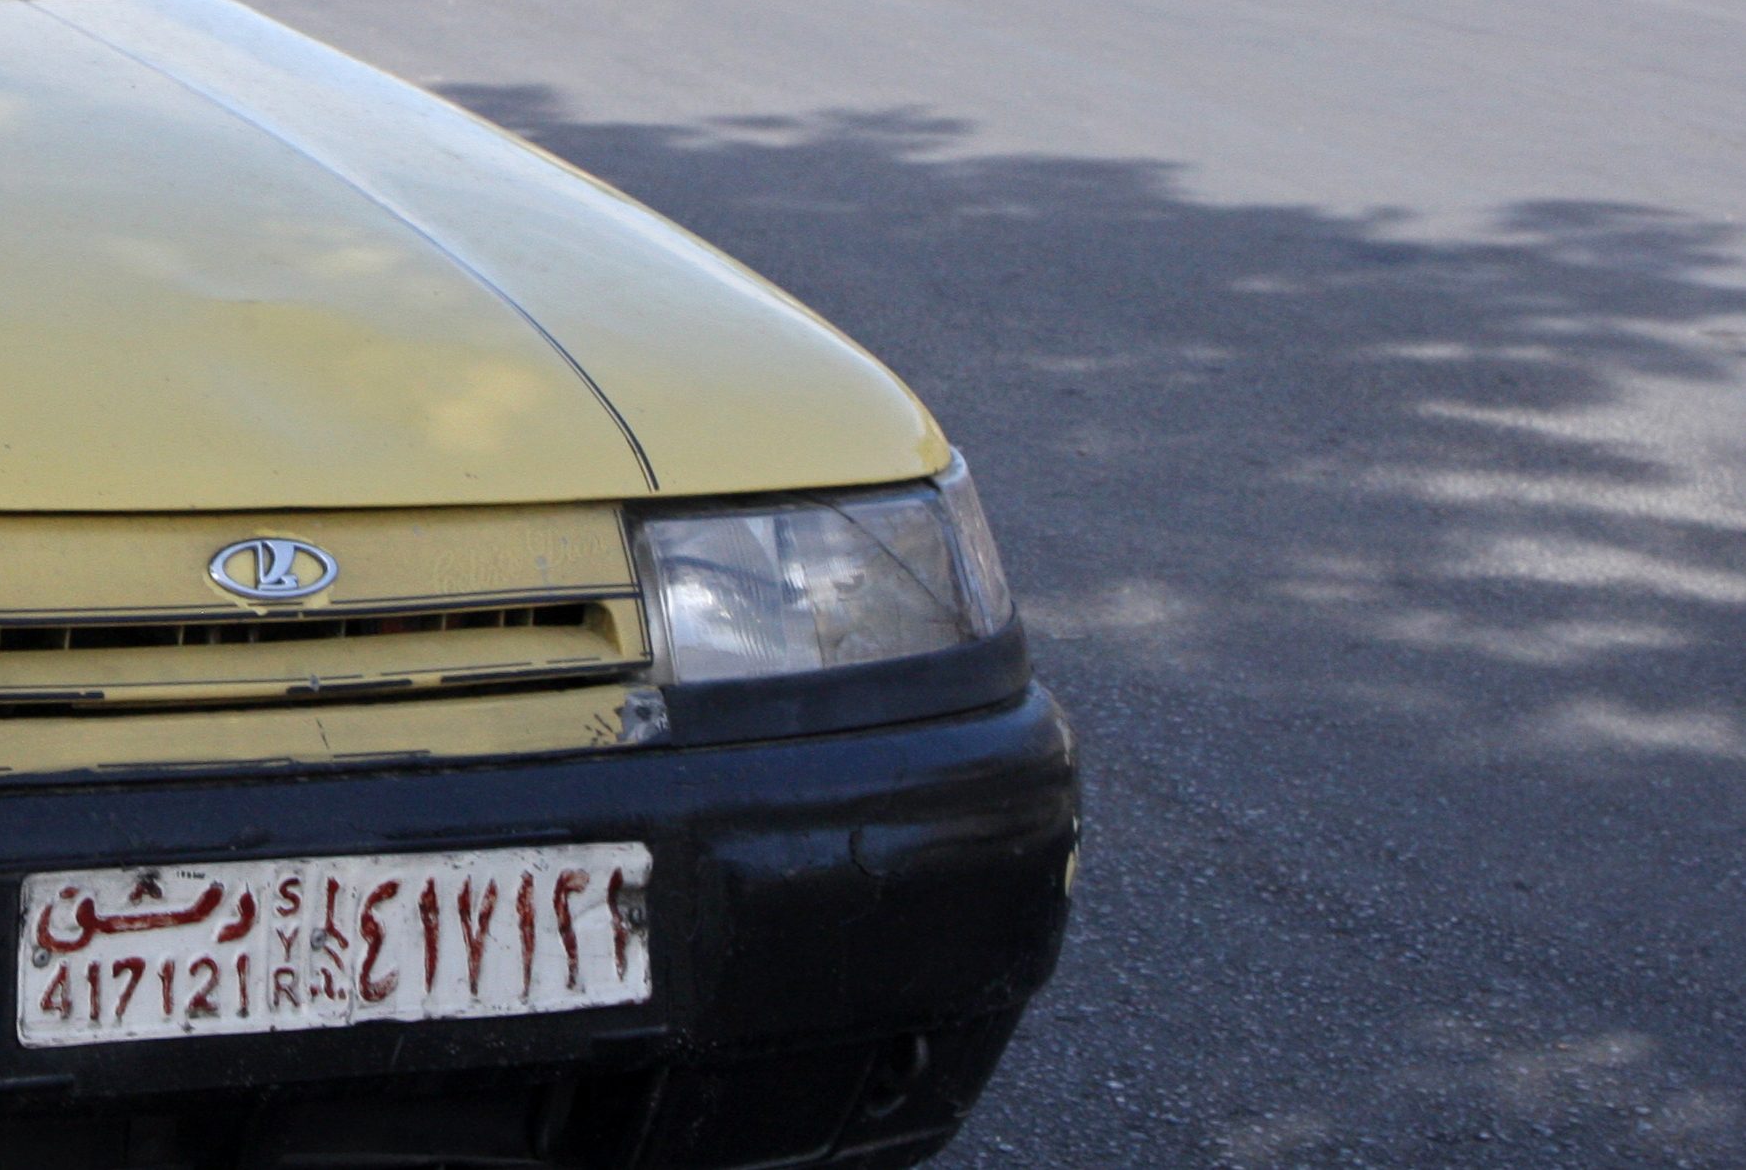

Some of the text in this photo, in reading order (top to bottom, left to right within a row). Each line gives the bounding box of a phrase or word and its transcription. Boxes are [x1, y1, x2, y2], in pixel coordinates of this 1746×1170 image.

[36, 880, 256, 953] دمشق
[358, 866, 628, 1004] ٤١٧١٢١
[40, 951, 251, 1019] 417121
